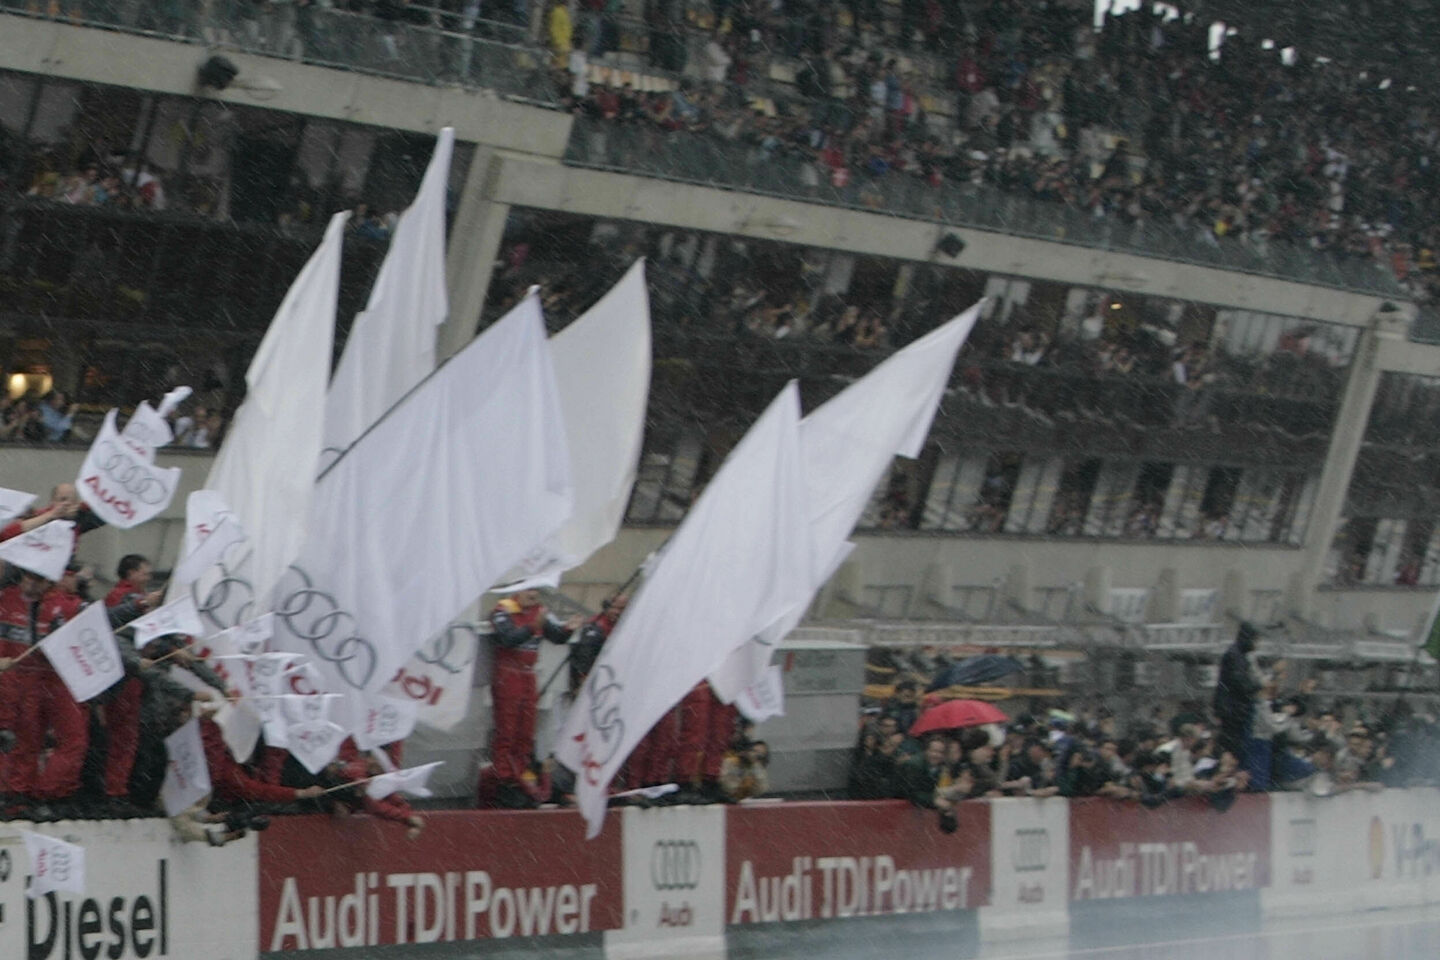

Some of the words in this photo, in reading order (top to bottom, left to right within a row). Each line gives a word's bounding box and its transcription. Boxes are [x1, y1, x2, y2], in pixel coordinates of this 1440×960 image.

[732, 856, 812, 924] Audi
[817, 856, 872, 918] TDI
[874, 854, 972, 915] Power
[1074, 842, 1135, 899] Audi
[1137, 843, 1182, 895] TDI
[1184, 841, 1257, 893] Power
[270, 872, 379, 952] Audi
[387, 872, 456, 943] TDI
[465, 870, 597, 940] Power
